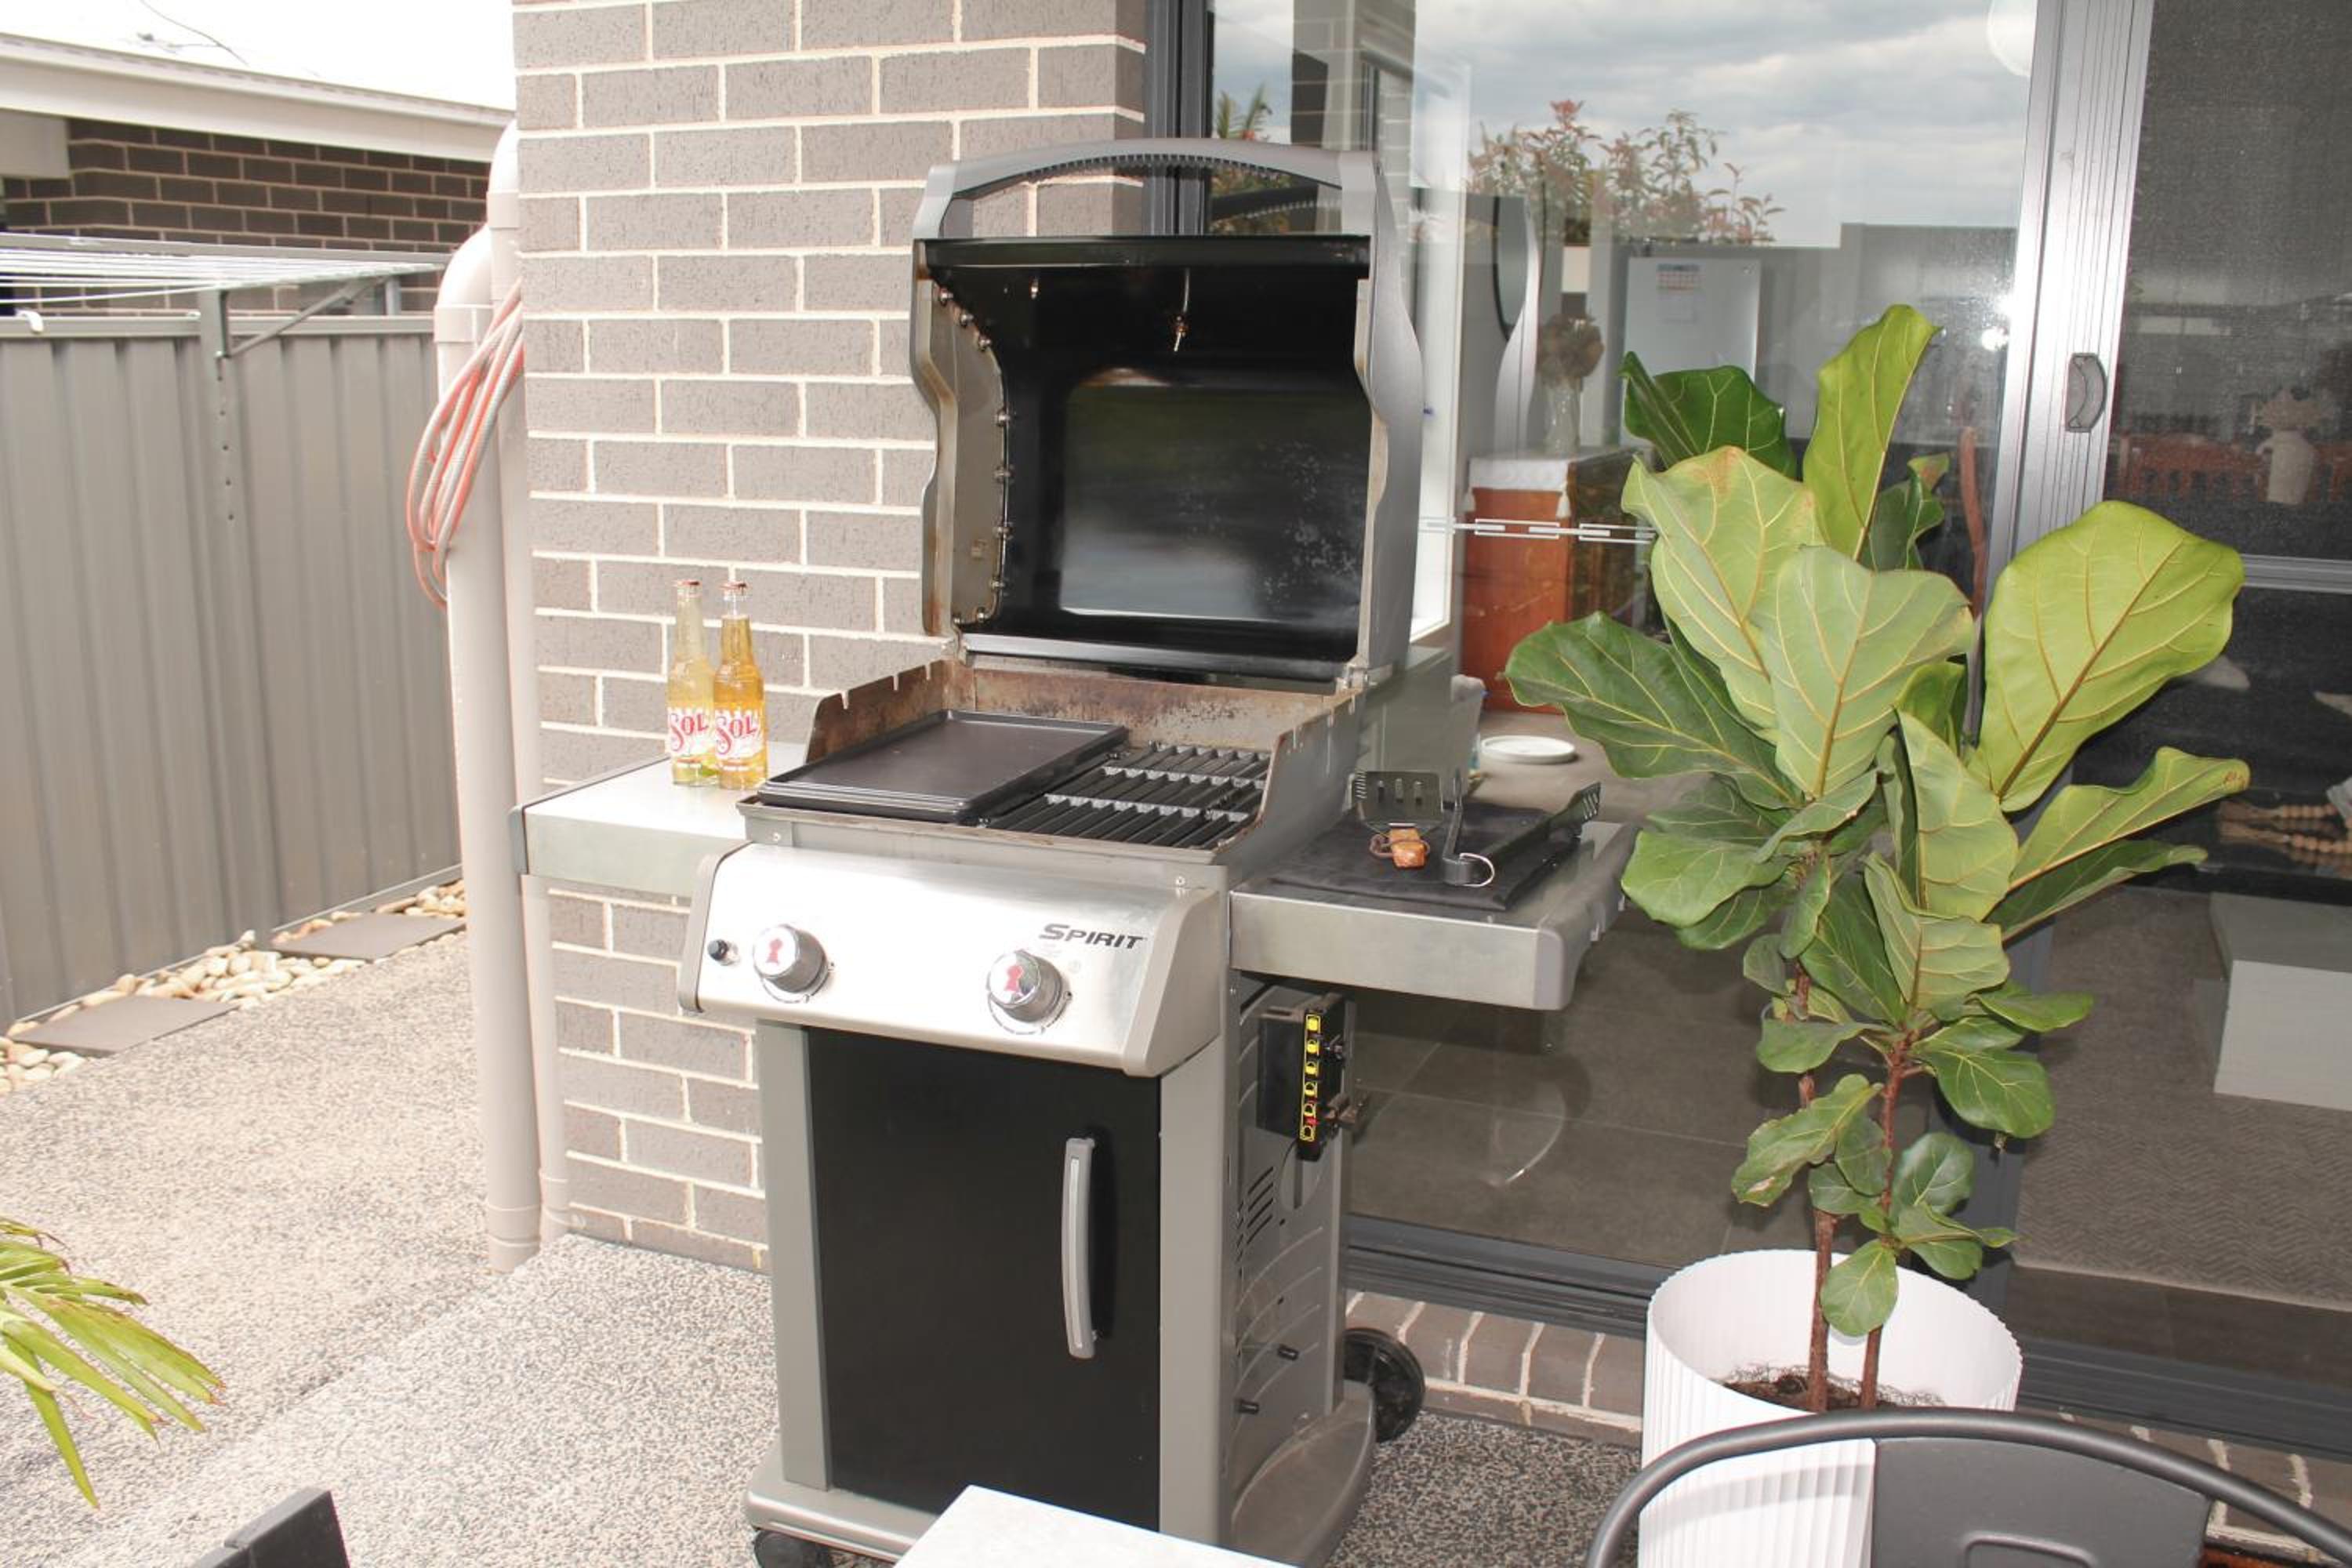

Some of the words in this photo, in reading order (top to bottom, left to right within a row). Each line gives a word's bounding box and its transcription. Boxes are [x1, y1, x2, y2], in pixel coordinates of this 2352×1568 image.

[670, 713, 709, 752] SOL
[715, 715, 757, 755] SOL
[1039, 923, 1144, 949] SPIRIT
